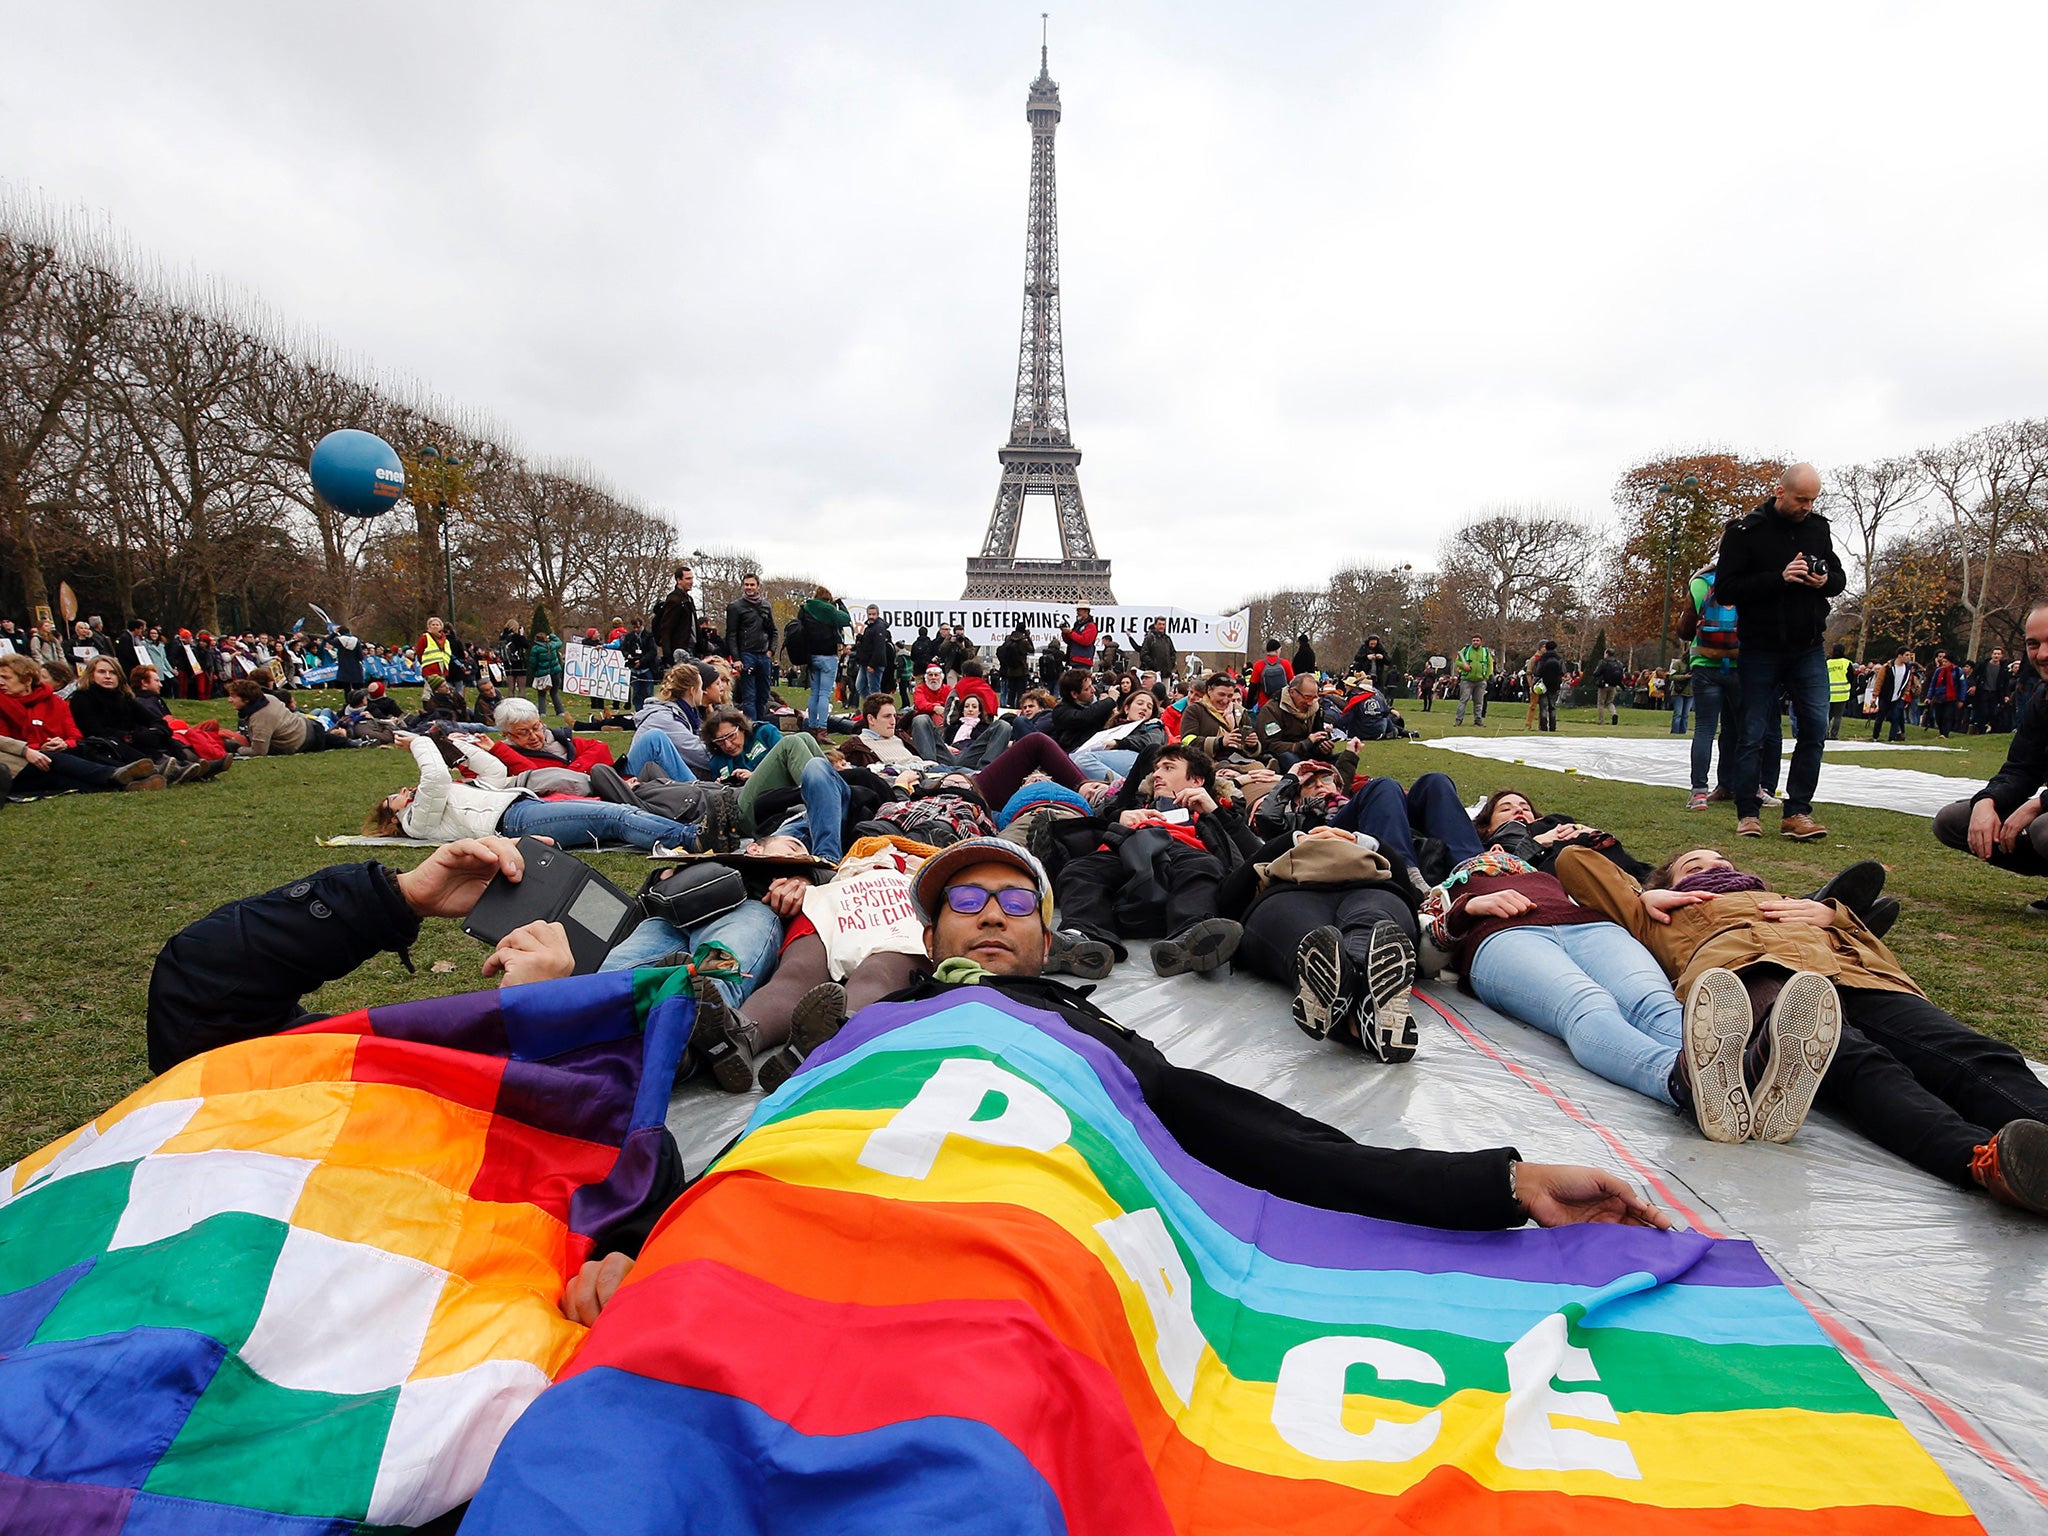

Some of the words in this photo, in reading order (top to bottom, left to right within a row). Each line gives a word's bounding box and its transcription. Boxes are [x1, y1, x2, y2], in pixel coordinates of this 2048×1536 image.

[883, 610, 944, 628] DEBOUT
[950, 611, 967, 627] ET
[972, 608, 1070, 629] DÉTERMINÉS
[1121, 617, 1138, 633] LE
[1144, 617, 1199, 634] CMAT
[581, 646, 608, 665] FOR
[606, 650, 620, 668] A
[565, 660, 629, 686] CLIMATE
[589, 678, 629, 701] PEACE
[841, 877, 908, 894] CHANGEON
[840, 899, 852, 911] LE
[837, 908, 867, 933] PAS
[868, 913, 881, 926] LE
[857, 1057, 1643, 1481] PACE
